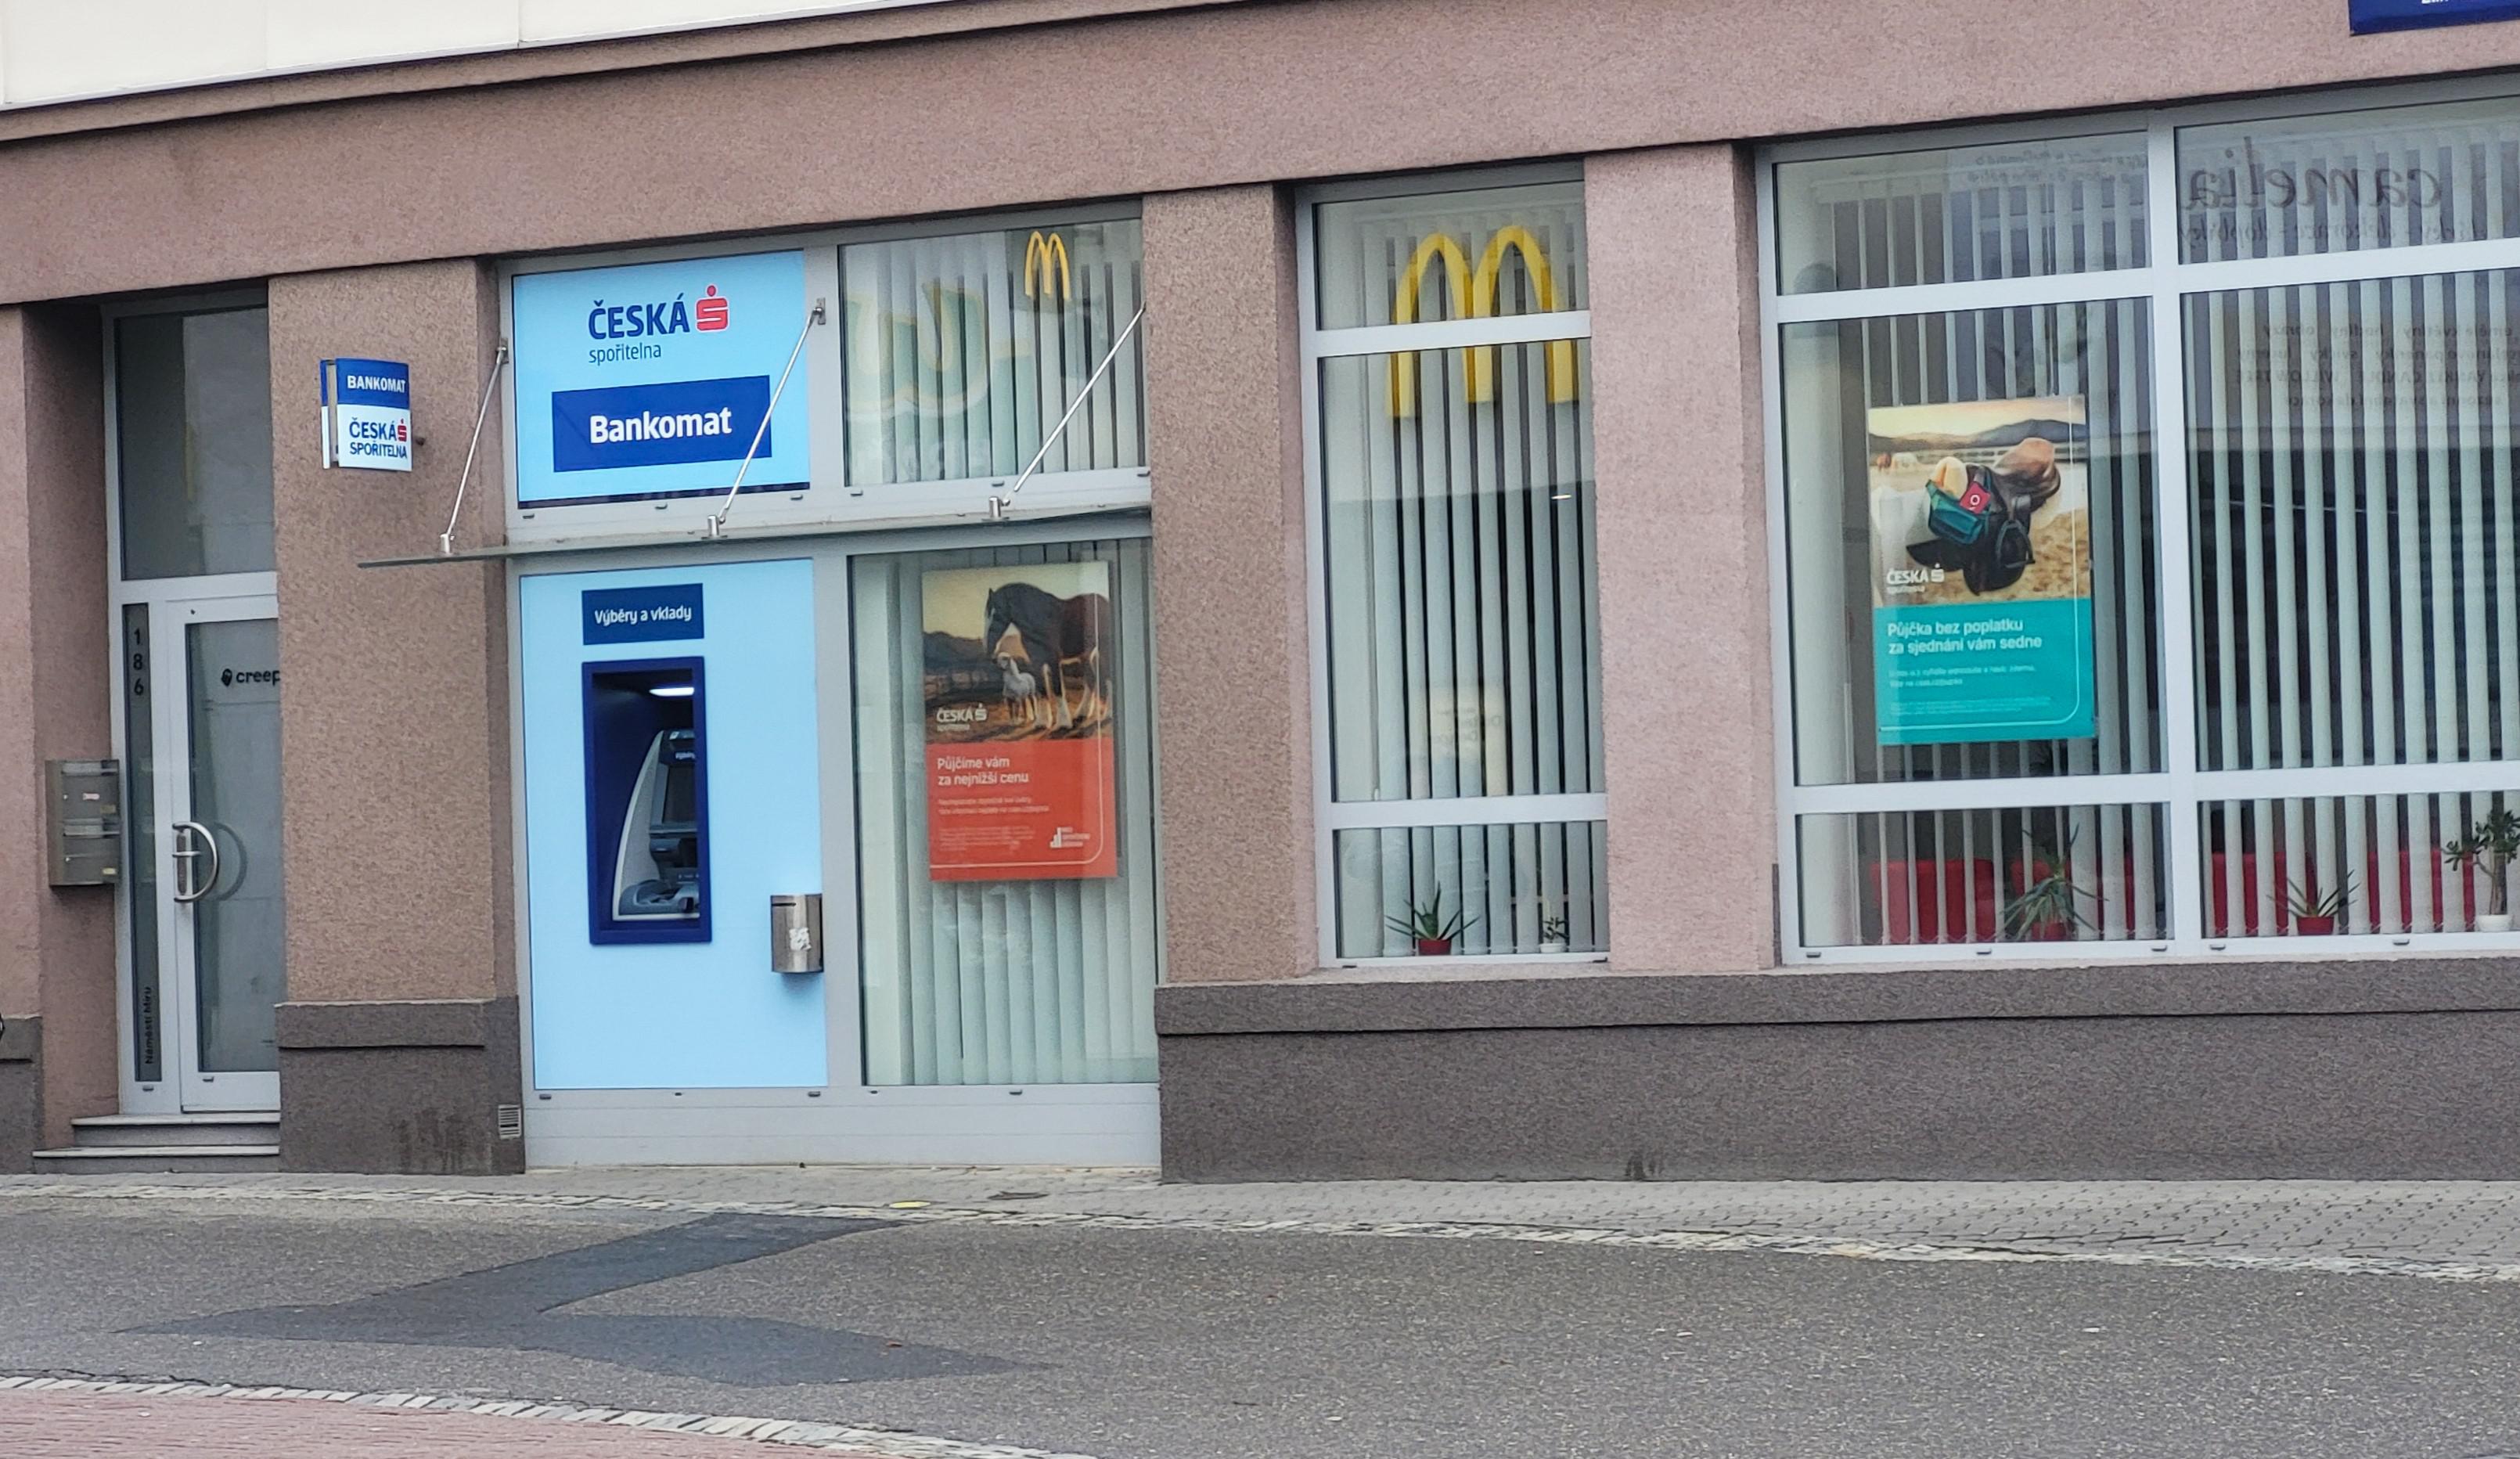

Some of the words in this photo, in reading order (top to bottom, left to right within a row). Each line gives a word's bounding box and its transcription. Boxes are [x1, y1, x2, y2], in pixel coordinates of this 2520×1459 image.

[589, 293, 689, 340] ČESKÁ
[589, 342, 661, 365] spořitelna
[347, 375, 405, 393] BANKOMAT
[349, 417, 397, 441] ČESKÁ
[589, 406, 732, 445] Bankomat
[350, 441, 407, 459] SPOŘITELNA
[594, 608, 638, 626] Výběry
[640, 611, 648, 621] a
[650, 604, 692, 622] vklady
[1887, 621, 1932, 639] Půjčka
[1935, 621, 1960, 635] bez
[1964, 618, 2023, 636] poplatku
[1888, 643, 1904, 655] za
[1908, 639, 1964, 656] sjednání
[1967, 639, 1996, 651] vám
[2000, 636, 2042, 650] sedne
[936, 708, 974, 722] ČESKÁ
[938, 756, 983, 772] Půjčíme
[985, 755, 1010, 769] vám
[938, 776, 951, 786] za
[953, 771, 998, 787] nejnižší
[1000, 773, 1029, 784] cenu
